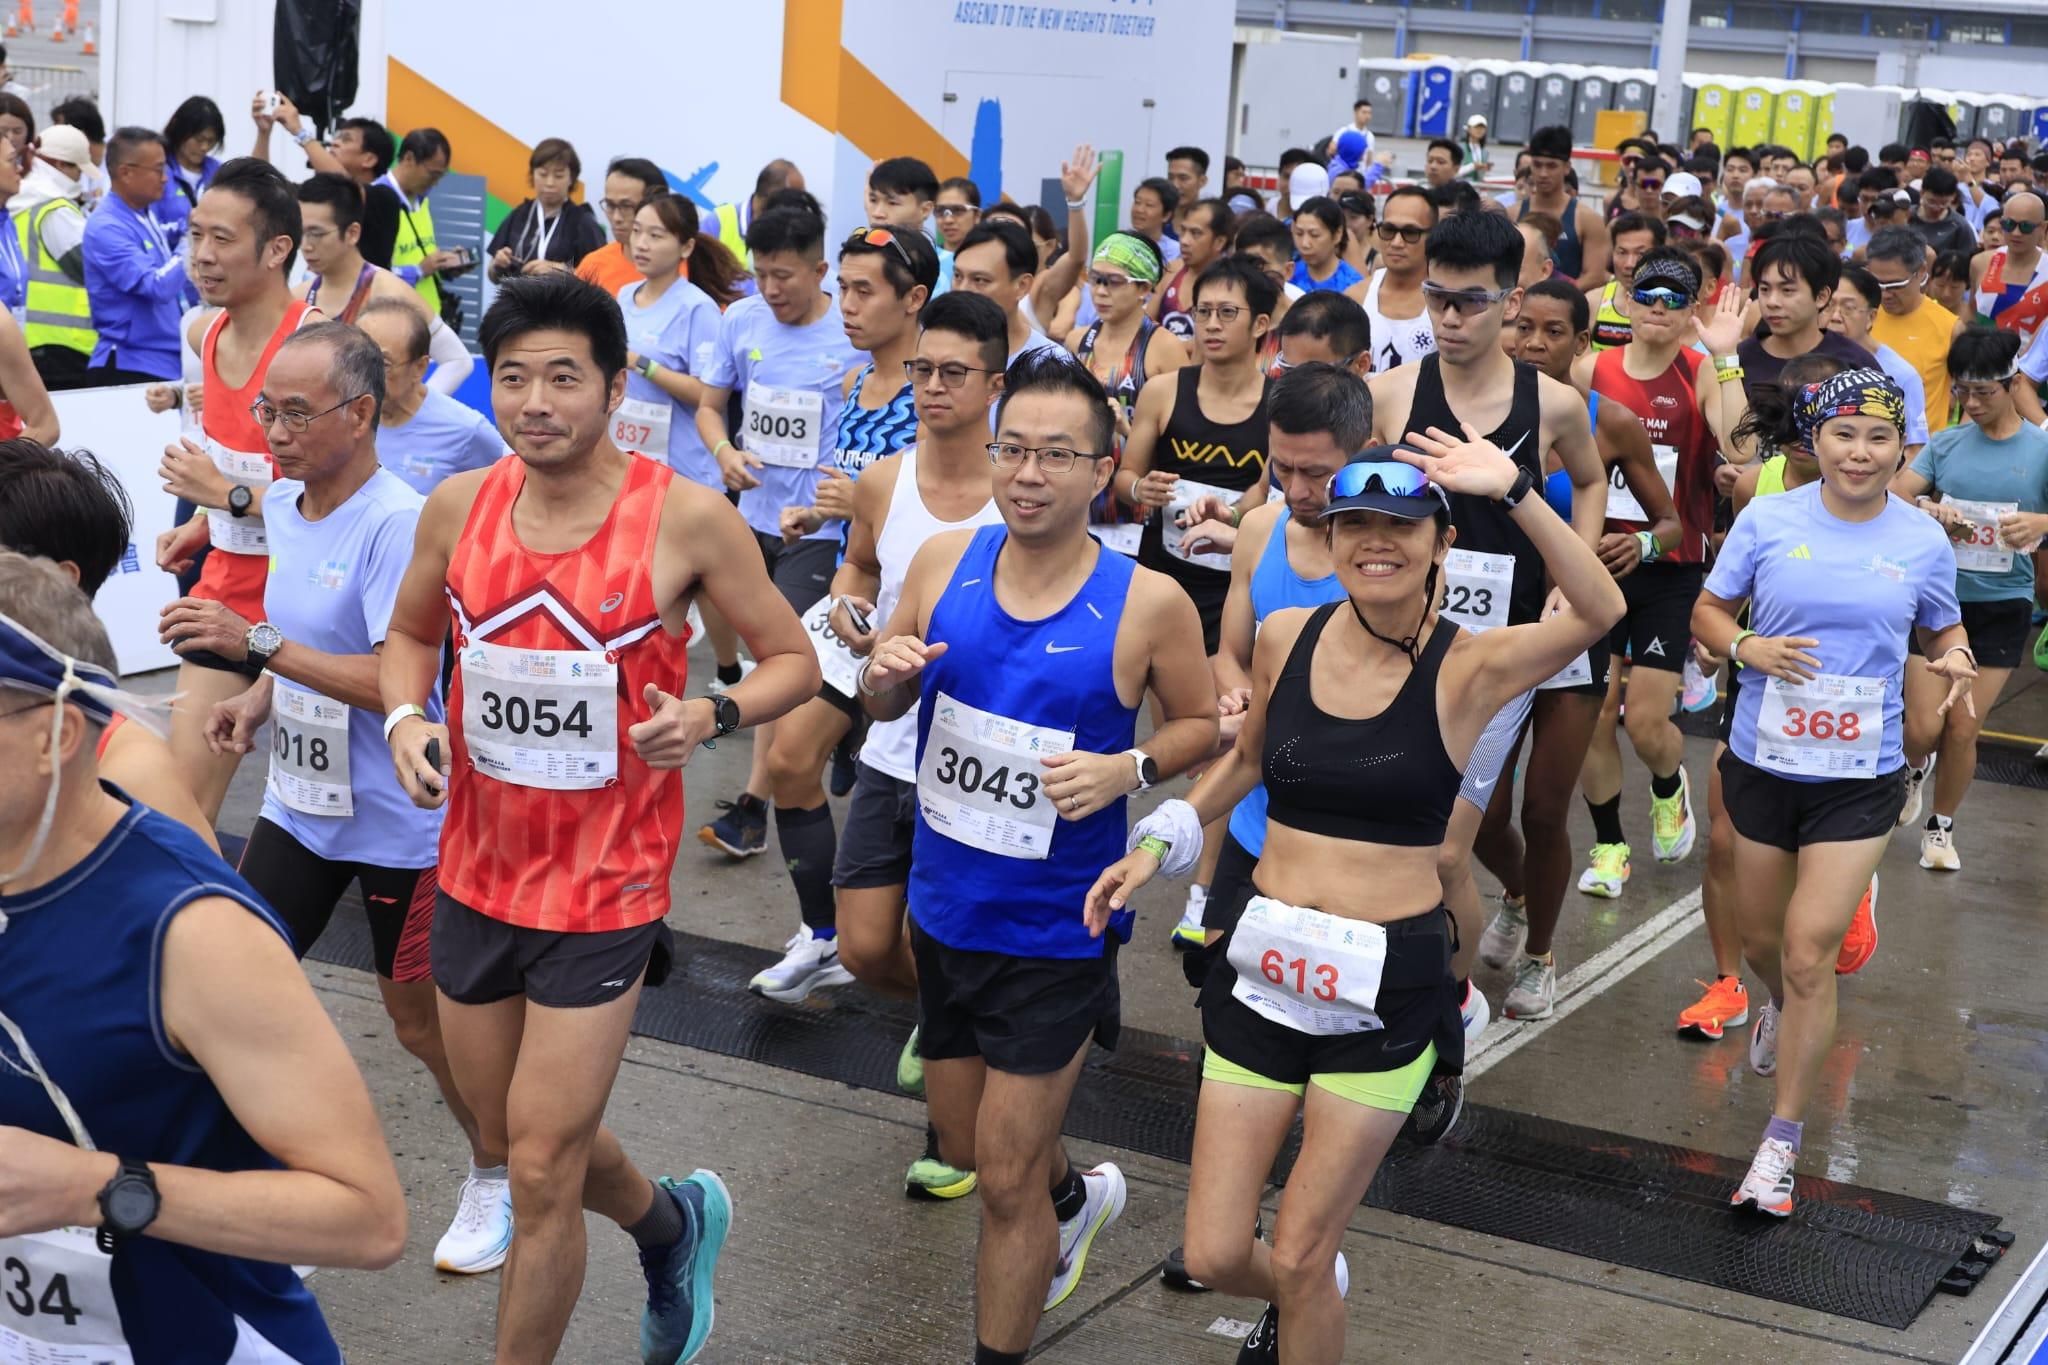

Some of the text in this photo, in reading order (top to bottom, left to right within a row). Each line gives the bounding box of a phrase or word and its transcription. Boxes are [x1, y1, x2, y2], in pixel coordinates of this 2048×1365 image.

[954, 1, 1156, 38] ASCEND TO THE NEW HEIGHTS TOGETHER
[616, 421, 652, 446] 837
[750, 409, 807, 440] 3003
[1647, 418, 1668, 430] MAN
[1648, 431, 1664, 439] LUB
[481, 690, 593, 739] 3054
[1781, 706, 1861, 742] 368
[936, 746, 1040, 810] 3043
[1260, 948, 1340, 1002] 613
[0, 1256, 83, 1326] 34
